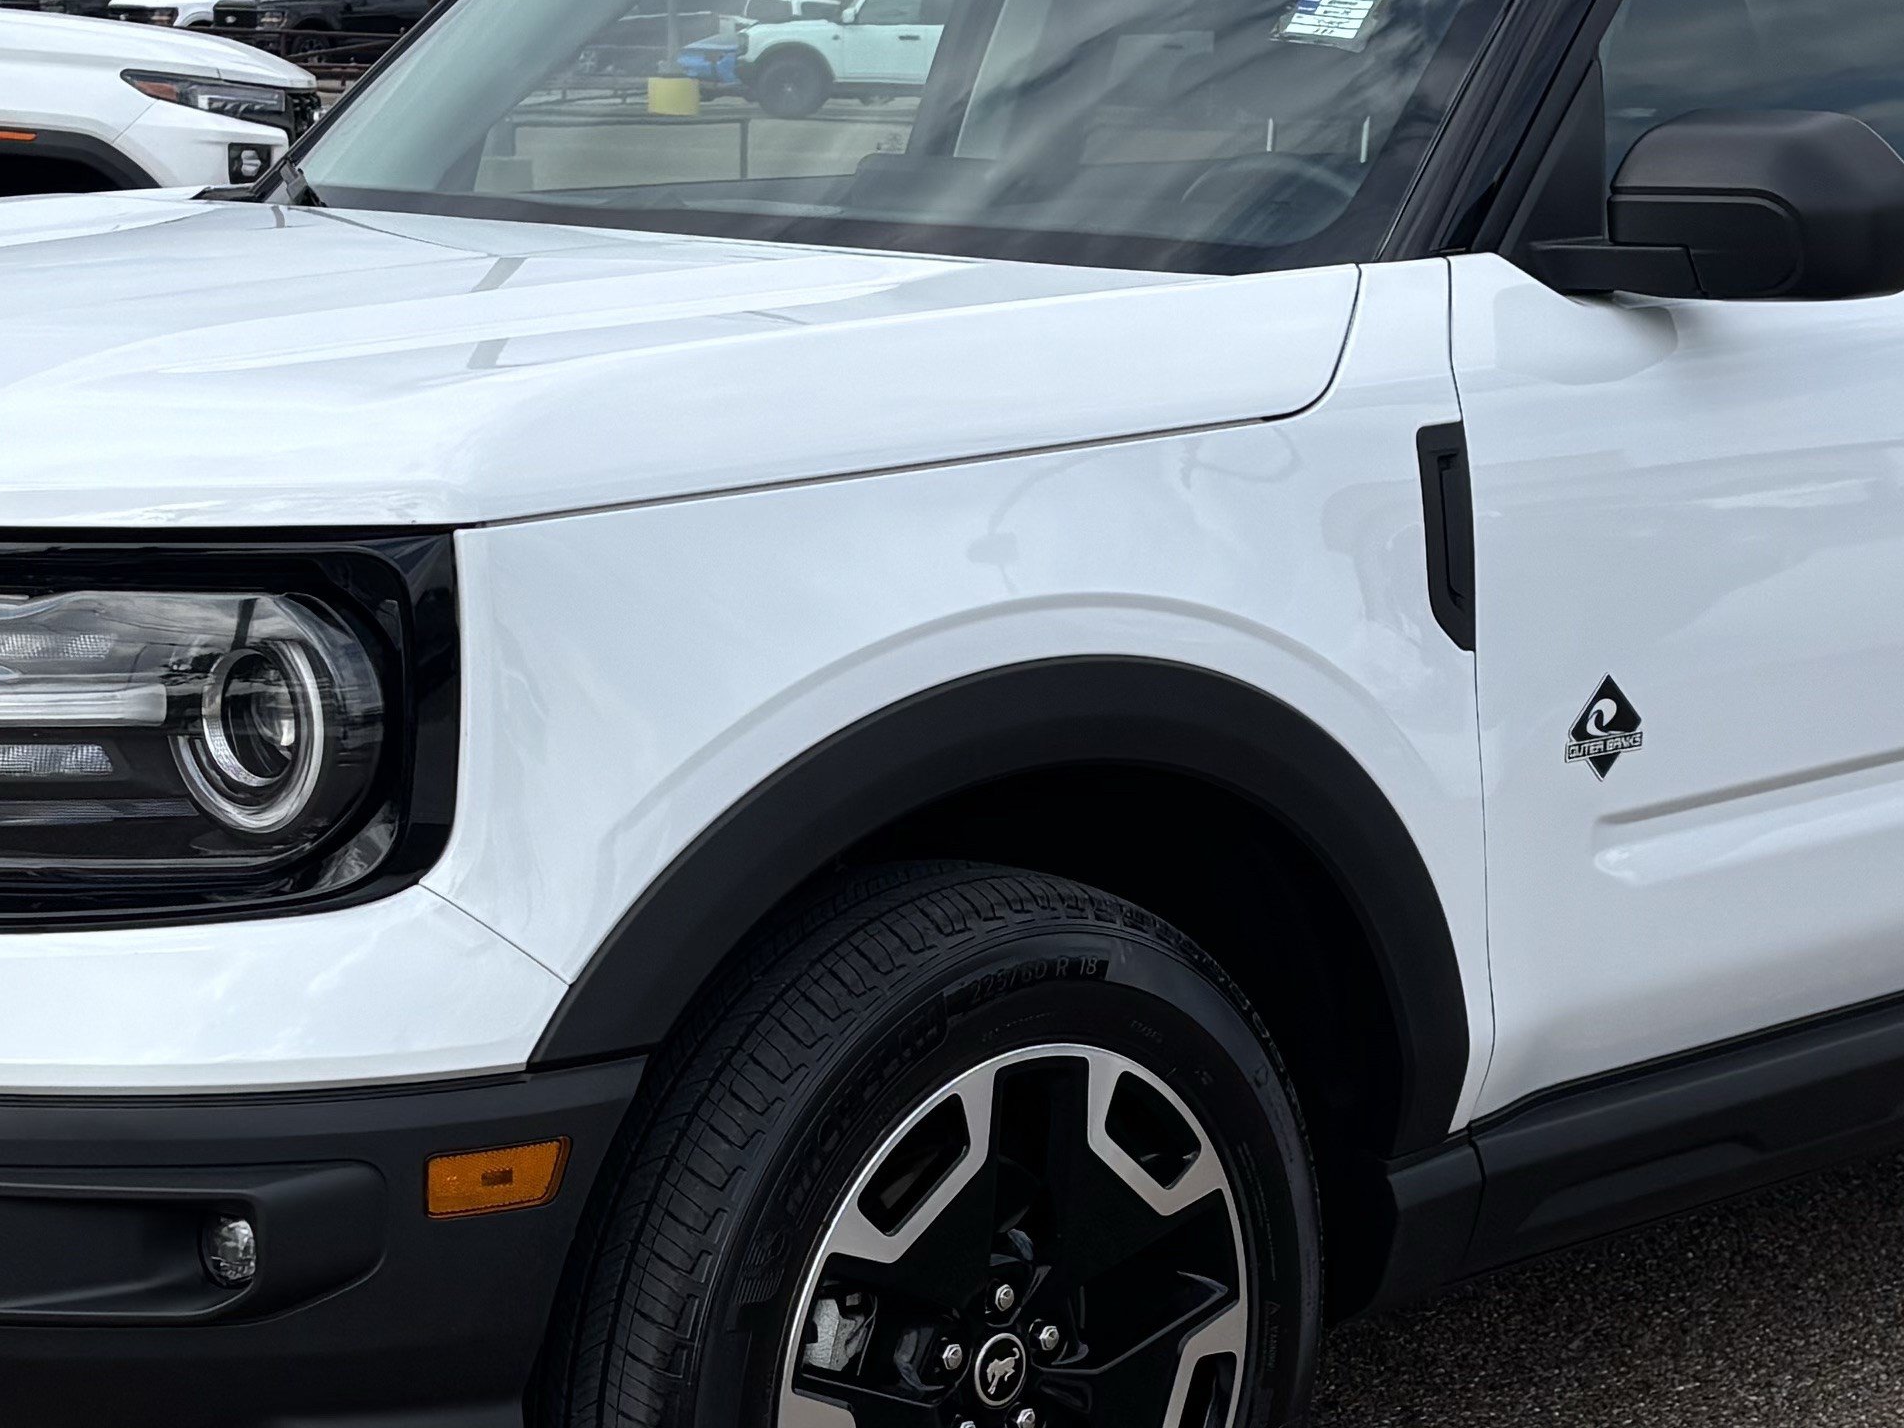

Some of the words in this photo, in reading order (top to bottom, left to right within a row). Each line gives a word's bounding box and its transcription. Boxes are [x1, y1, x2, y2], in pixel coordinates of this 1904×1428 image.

[1569, 742, 1604, 757] OUTER
[1606, 735, 1641, 751] BANKS
[1056, 956, 1071, 978] R
[1079, 956, 1098, 976] 18
[779, 1003, 941, 1215] MICHELIN
